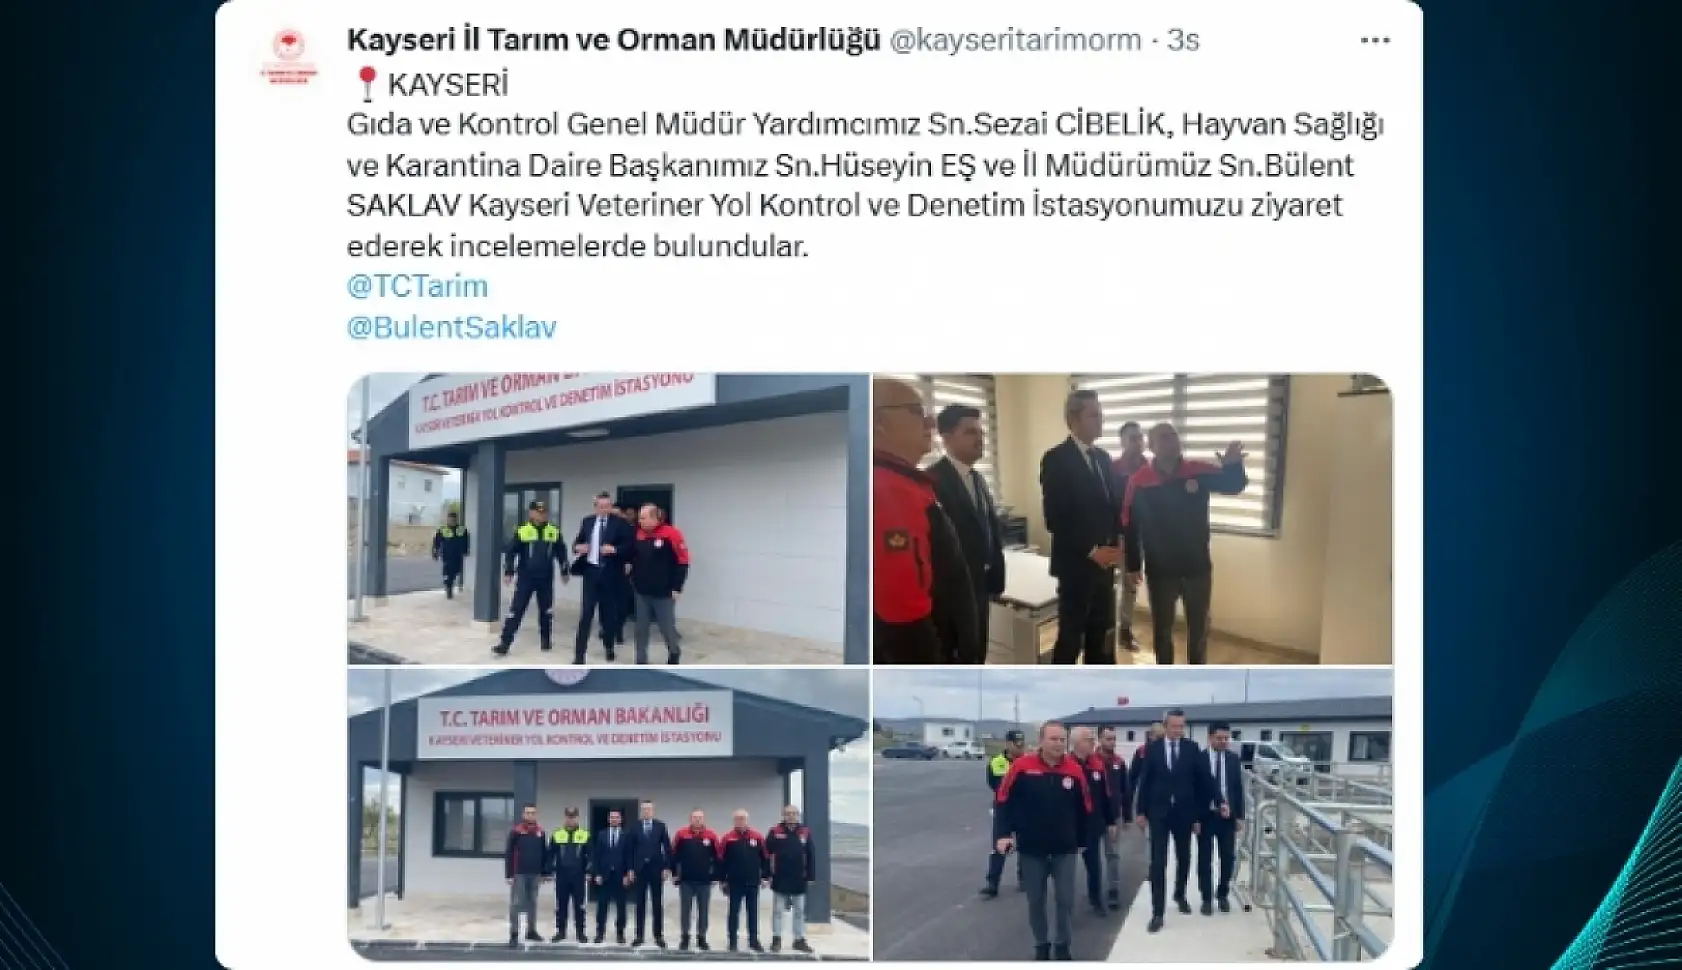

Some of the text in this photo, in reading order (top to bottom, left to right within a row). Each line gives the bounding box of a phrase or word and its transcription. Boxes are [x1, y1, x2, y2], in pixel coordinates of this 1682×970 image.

[347, 21, 1201, 58] Kayseri İl Tarım ve Orman Müdürlüğü @kayseritarimorm 3s
[388, 67, 509, 97] KAYSERİ
[346, 106, 1384, 141] Gıda ve Kontrol Genel Müdür Yardımcımız Sn.Sezai CİBELİK, Hayvan Sağlığı
[346, 148, 1356, 183] ve Karantina Daire Başkanımız Sn.Hüseyin EŞ ve İl Müdürümüz Sn.Bülent
[346, 187, 1344, 222] SAKLAV Kayseri Veteriner Yol Kontrol ve Denetim İstasyonumuzu ziyaret
[346, 232, 809, 258] ederek incelemelerde bulundular.
[348, 272, 488, 299] @TCTarim
[348, 313, 557, 340] @BulentSaklav
[443, 382, 479, 407] TARIM
[480, 376, 500, 399] VE
[440, 702, 709, 728] T.C. TARIM VE ORMAN BAKANLIĞI
